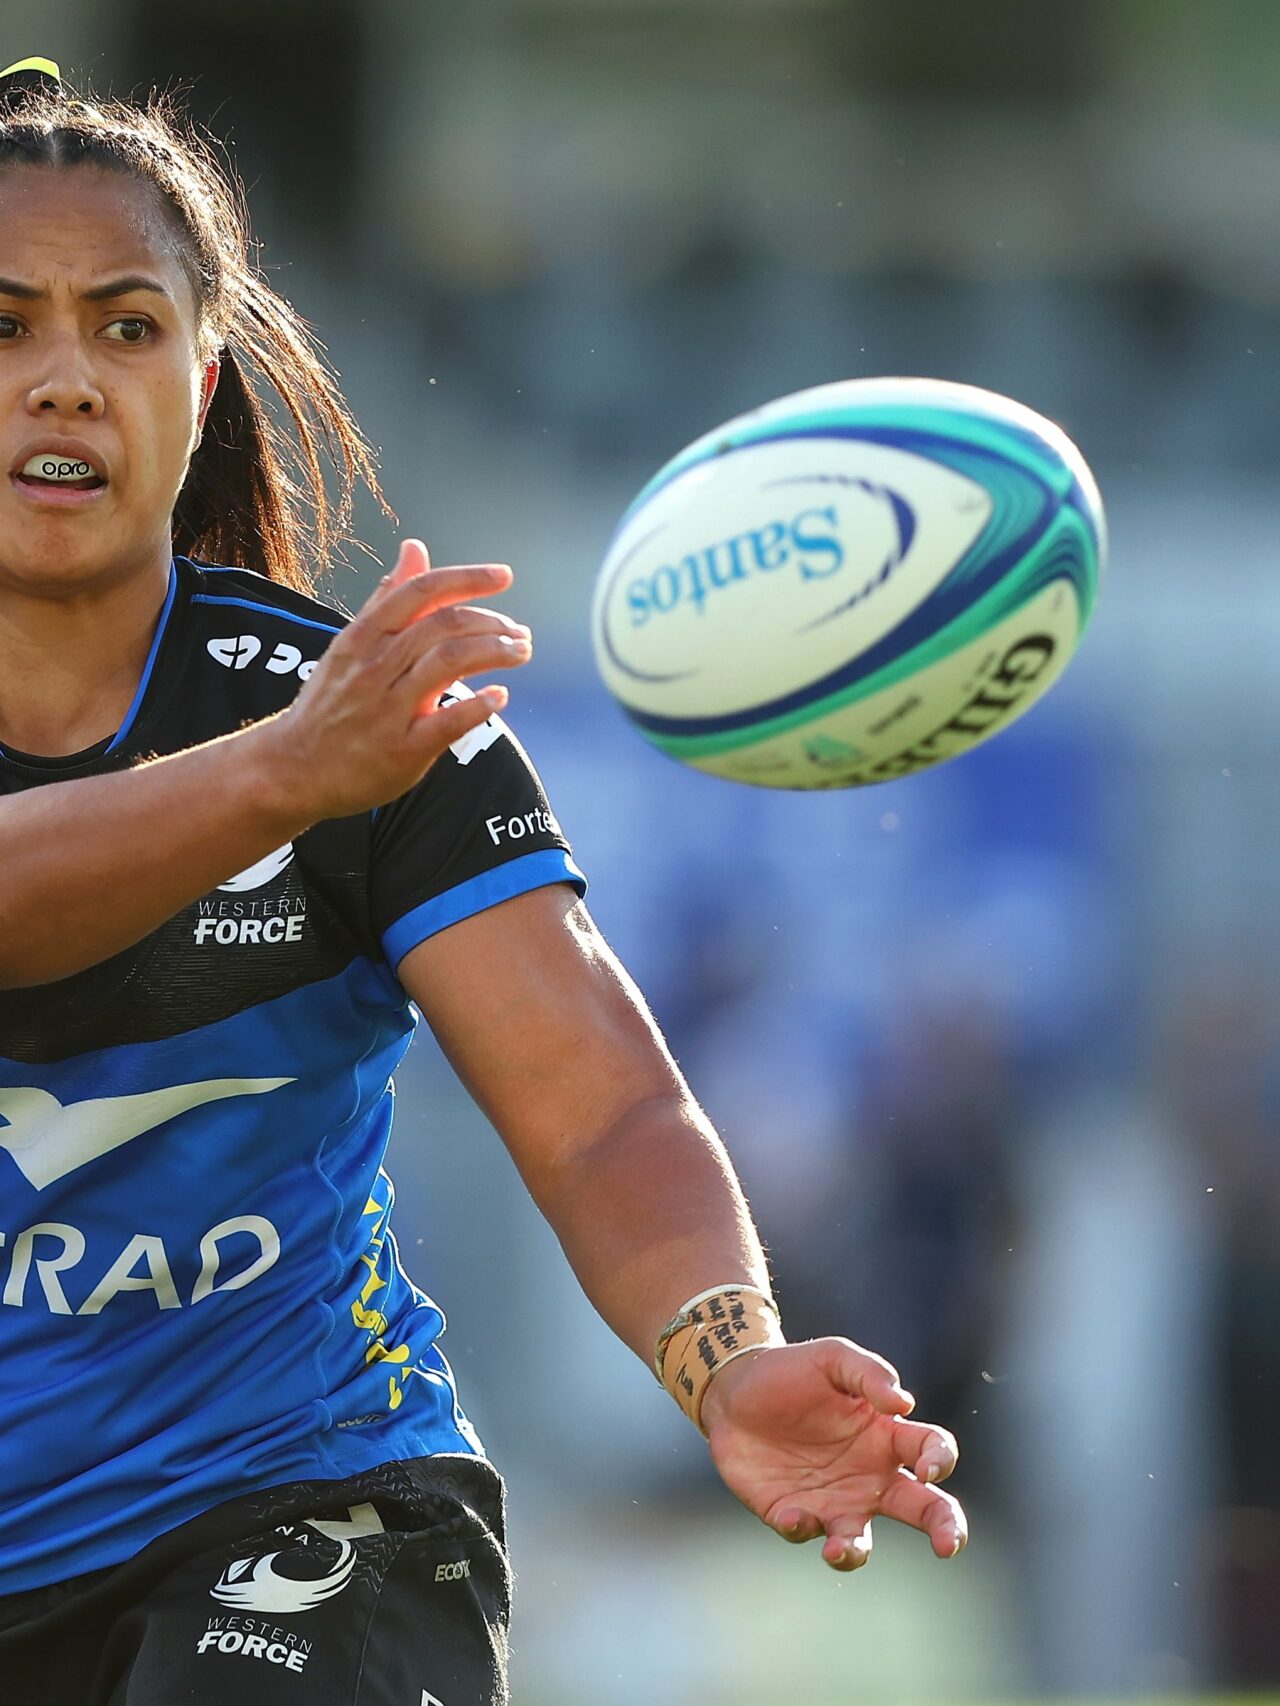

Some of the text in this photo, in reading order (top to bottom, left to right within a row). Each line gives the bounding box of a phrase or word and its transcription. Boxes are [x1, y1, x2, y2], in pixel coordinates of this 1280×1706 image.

[41, 461, 90, 478] opro
[626, 505, 843, 628] Santos
[485, 806, 562, 846] Forte
[198, 896, 307, 917] WESTERN
[193, 914, 306, 945] FORCE
[196, 1630, 309, 1673] FORCE
[207, 1616, 313, 1654] WESTERN
